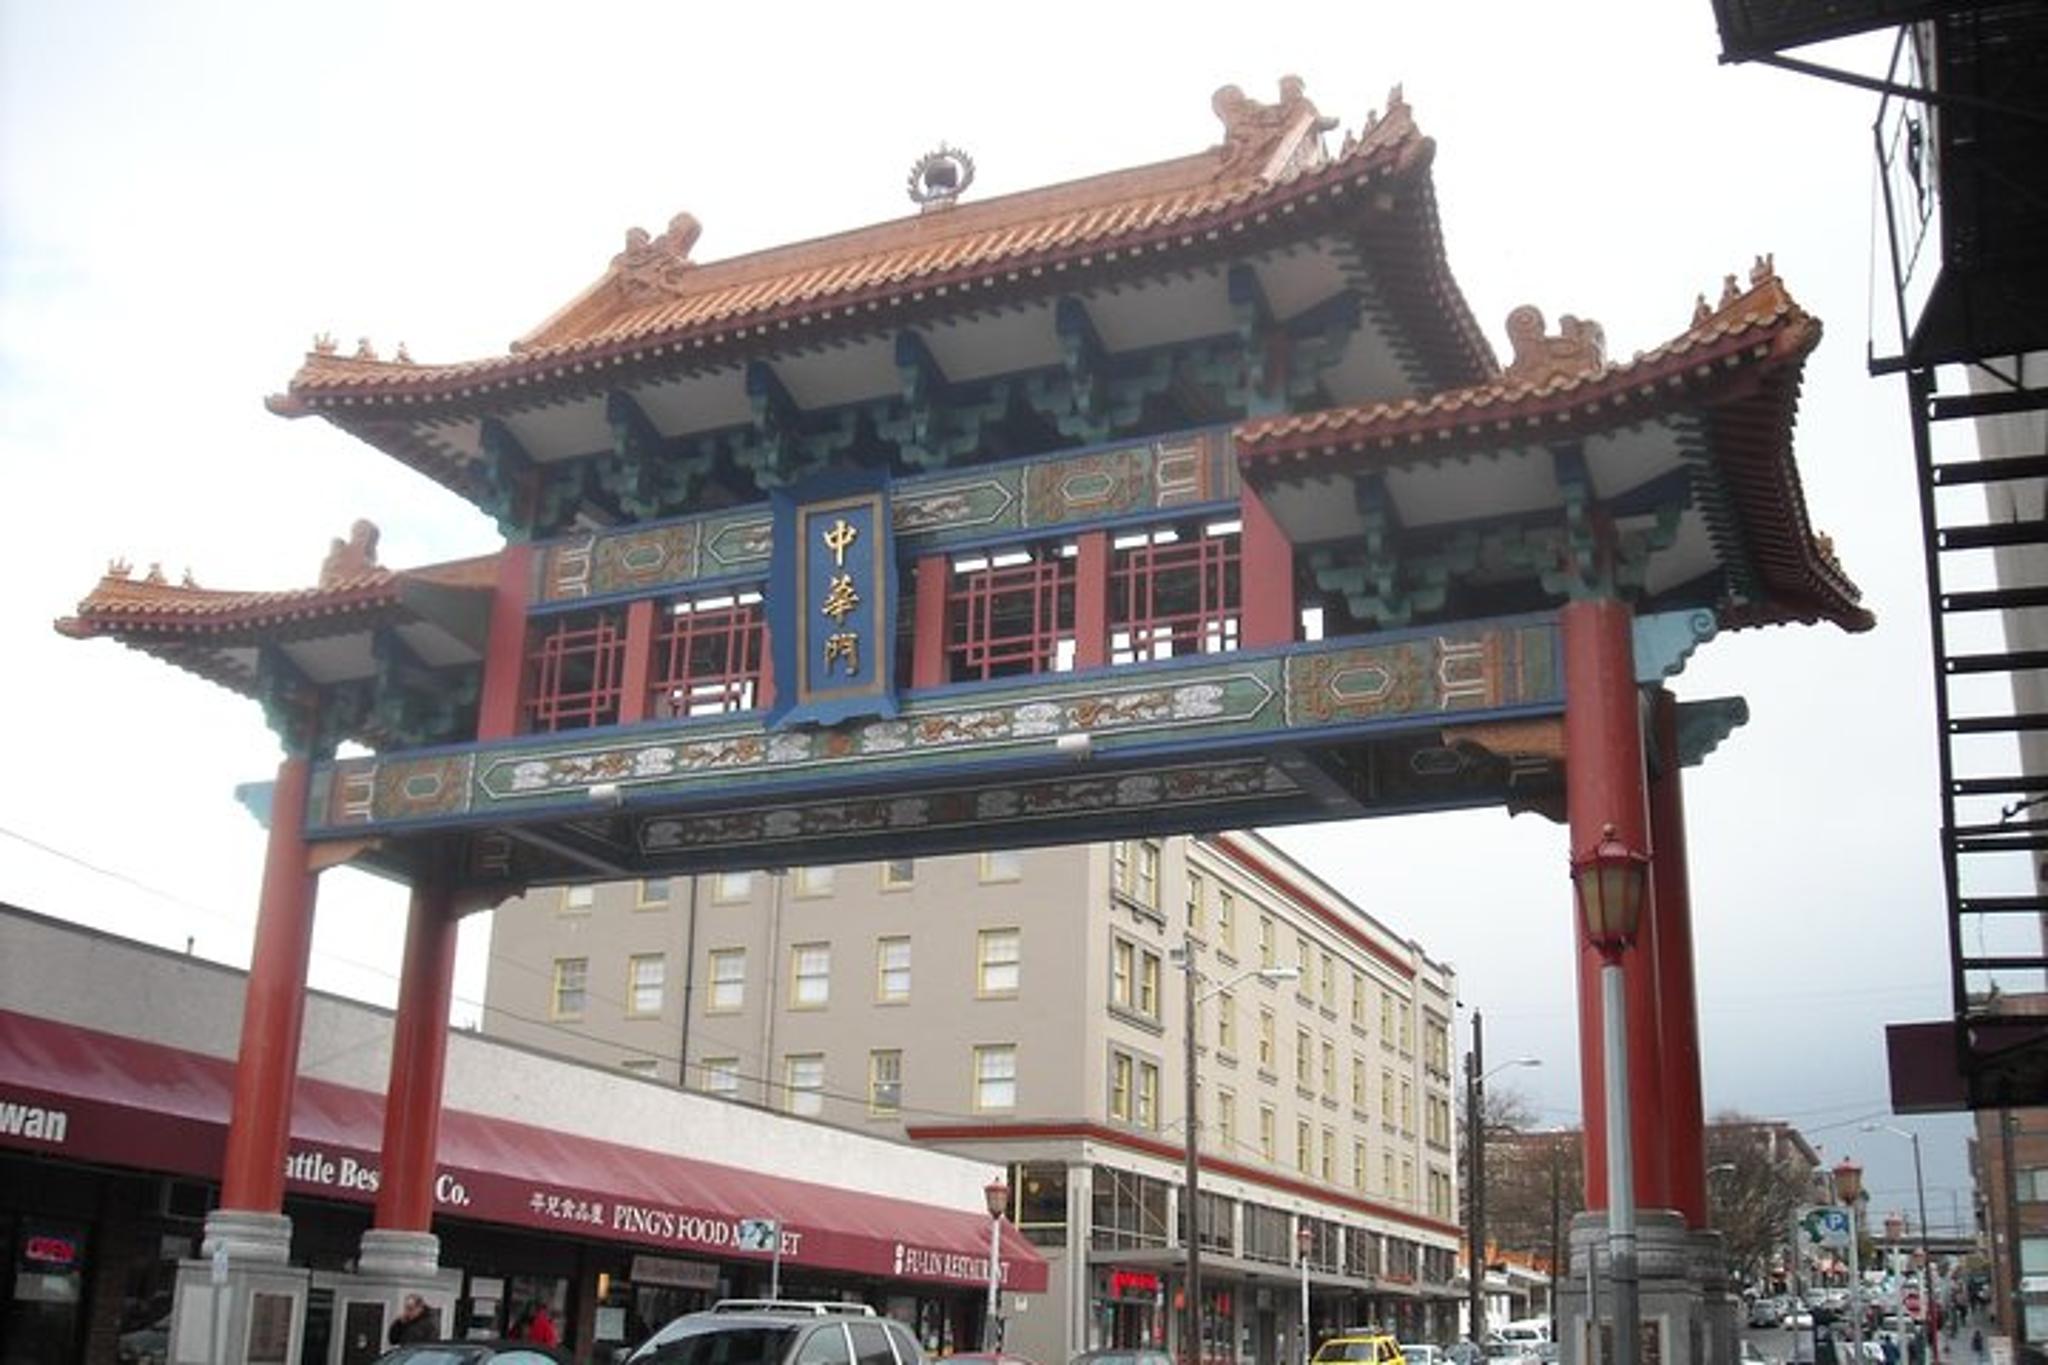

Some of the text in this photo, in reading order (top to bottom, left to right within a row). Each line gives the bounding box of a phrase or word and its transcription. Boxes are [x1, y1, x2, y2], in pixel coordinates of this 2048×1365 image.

[822, 519, 861, 676] 中華門
[435, 1174, 470, 1207] Co.
[613, 1205, 674, 1238] PING'S
[677, 1216, 729, 1247] FOOD
